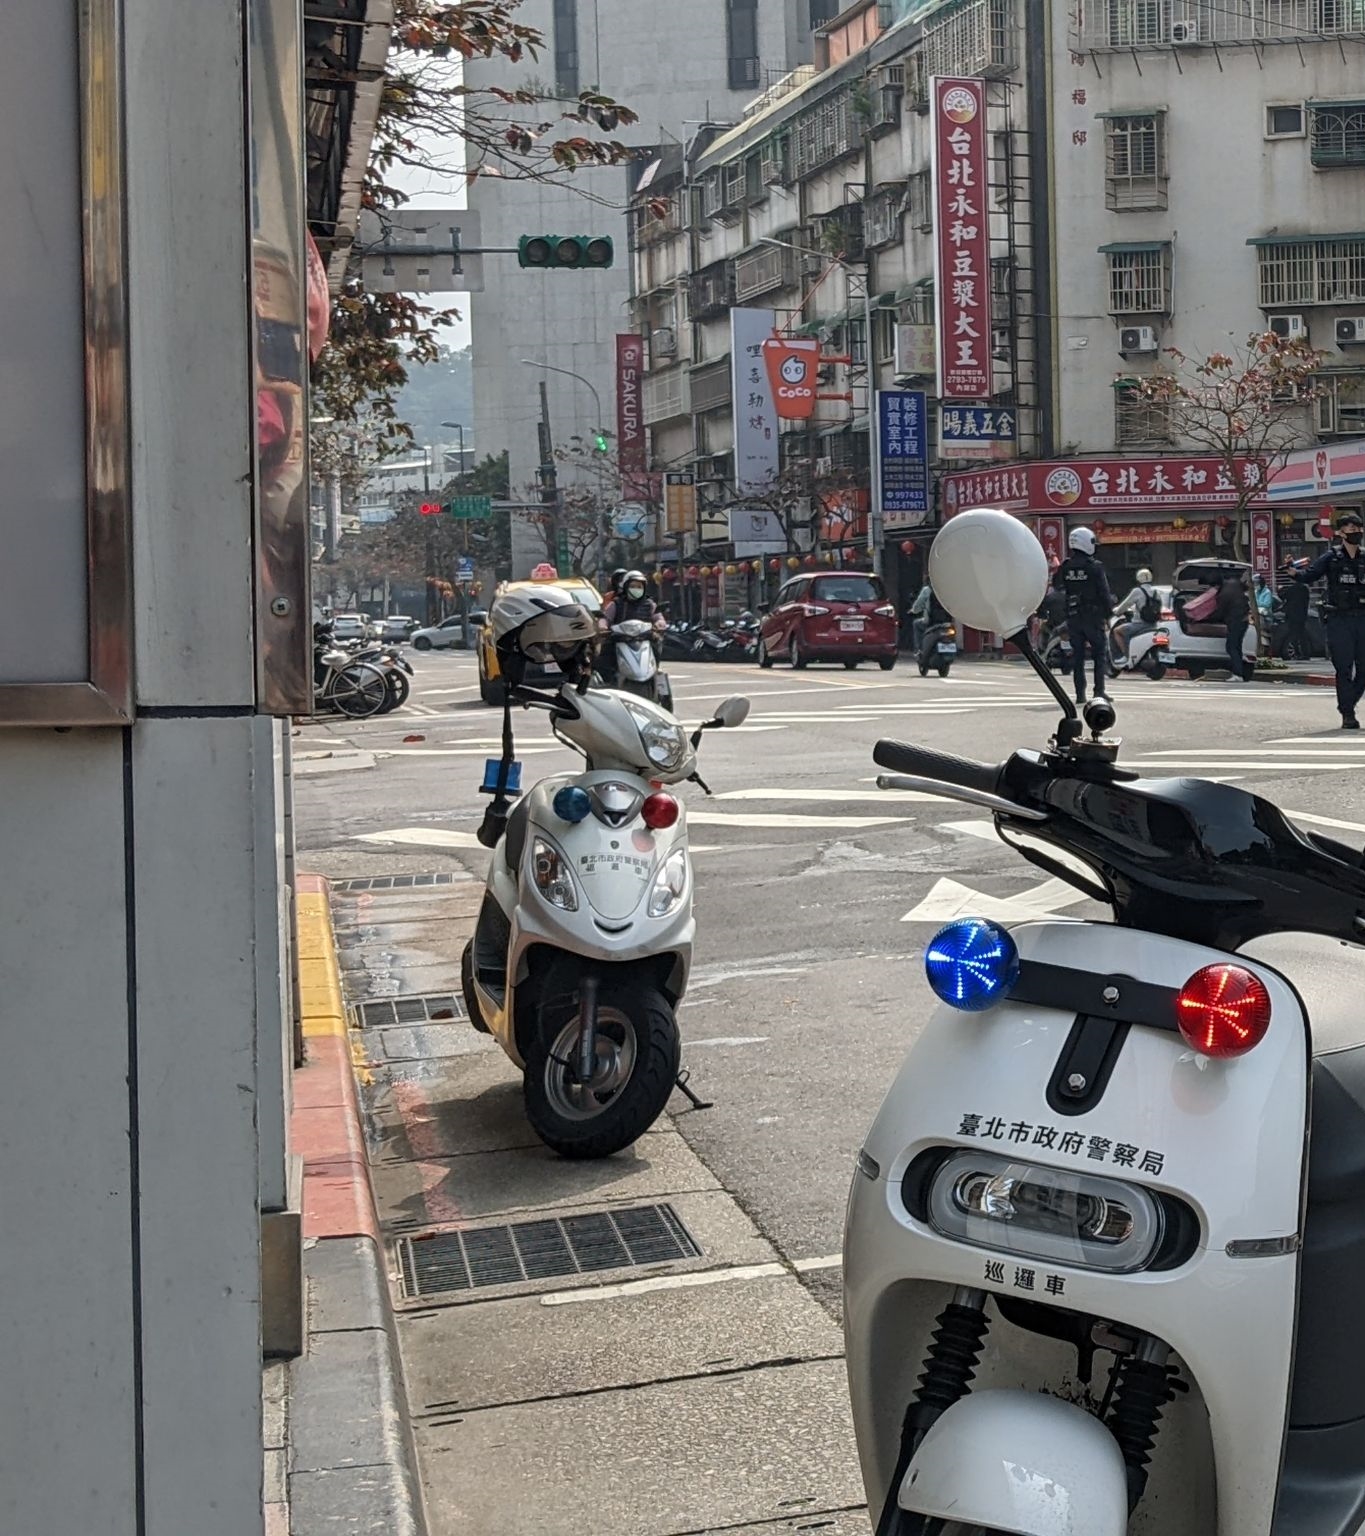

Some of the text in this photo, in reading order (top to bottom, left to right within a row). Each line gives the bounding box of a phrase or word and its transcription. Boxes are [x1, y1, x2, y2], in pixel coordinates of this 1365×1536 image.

[946, 126, 981, 366] 台北永和豆漿大王
[622, 368, 638, 442] SAKURA
[778, 386, 811, 398] CoCo
[903, 397, 919, 455] 裝修工程
[958, 472, 1029, 504] 台北永和豆漿大王
[1256, 537, 1269, 570] 早點
[956, 1113, 1165, 1176] 臺北市政府警察局
[984, 1259, 1066, 1295] 巡邏車
